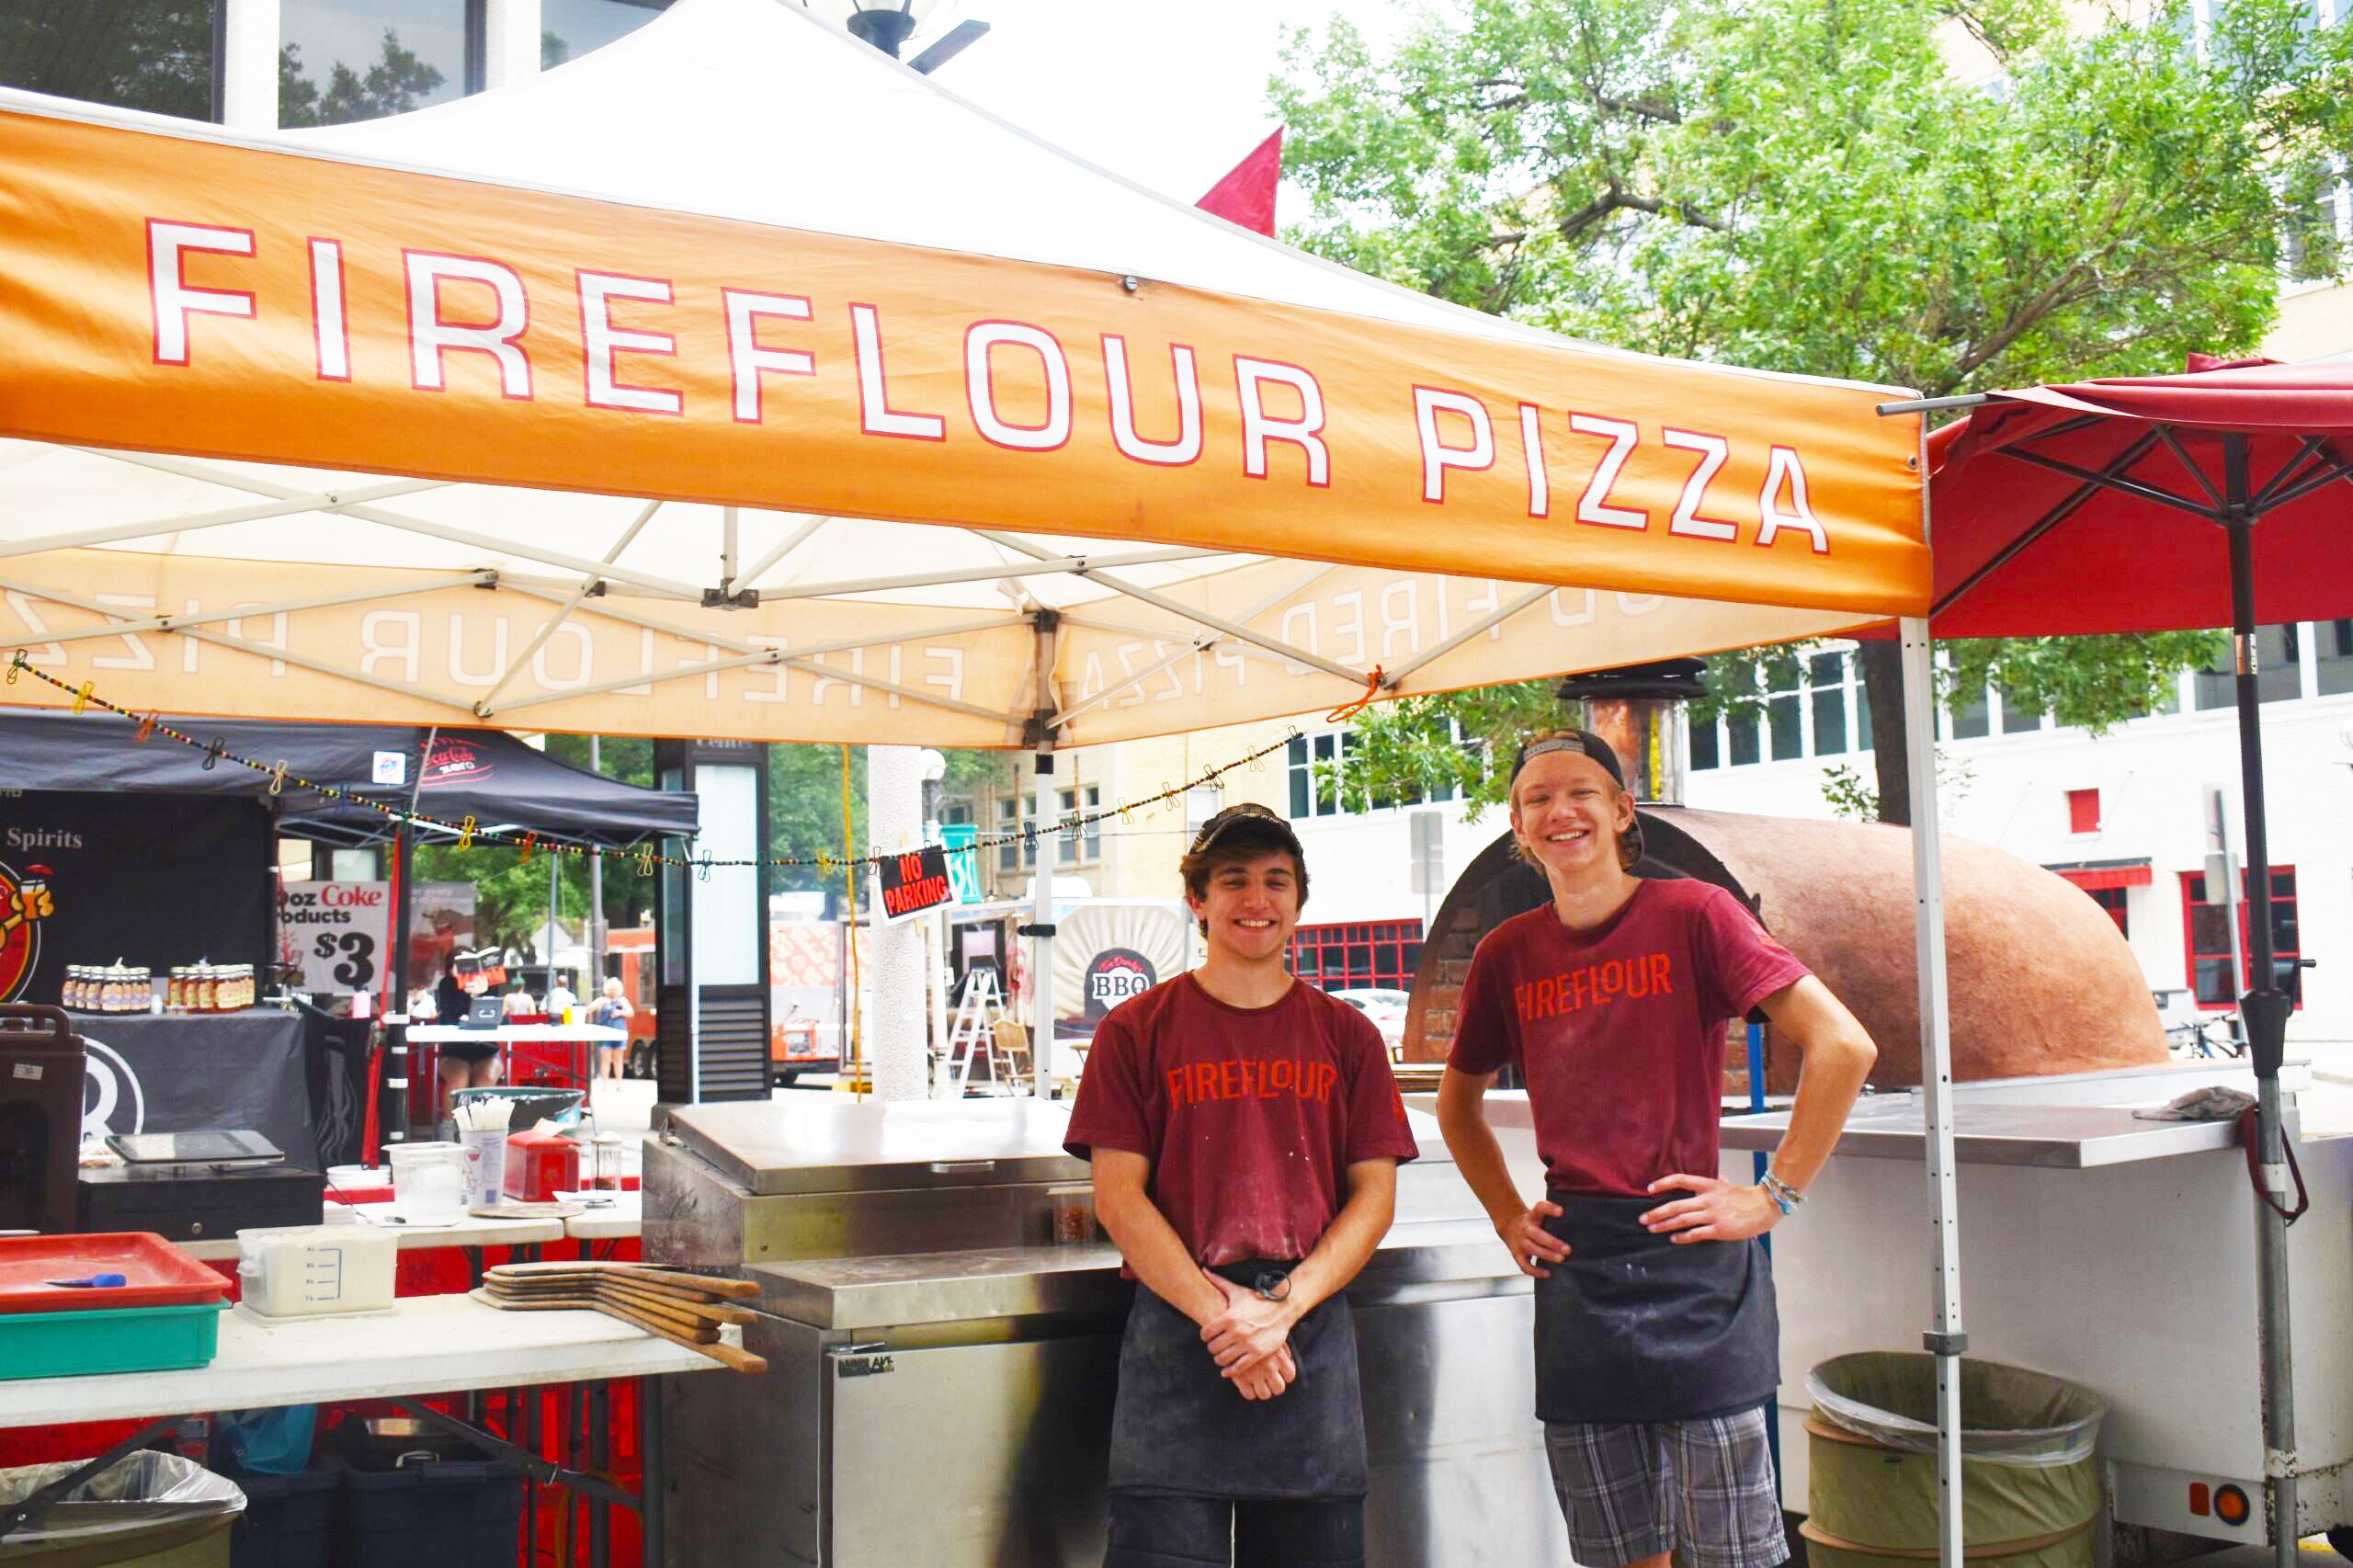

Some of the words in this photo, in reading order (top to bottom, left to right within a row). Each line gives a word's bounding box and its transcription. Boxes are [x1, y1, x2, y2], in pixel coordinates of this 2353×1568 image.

[145, 217, 1330, 489] FIREFLOUR
[1412, 383, 1830, 555] PIZZA
[7, 827, 83, 852] Spirits
[898, 856, 923, 883] NO
[323, 884, 382, 907] Coke
[884, 875, 949, 916] PARKING
[279, 908, 351, 925] oducts
[313, 931, 375, 988] $3
[1095, 976, 1147, 996] BBQ
[1515, 952, 1674, 1022] FIREFLOUR
[1166, 1058, 1338, 1110] FIREFLOUR
